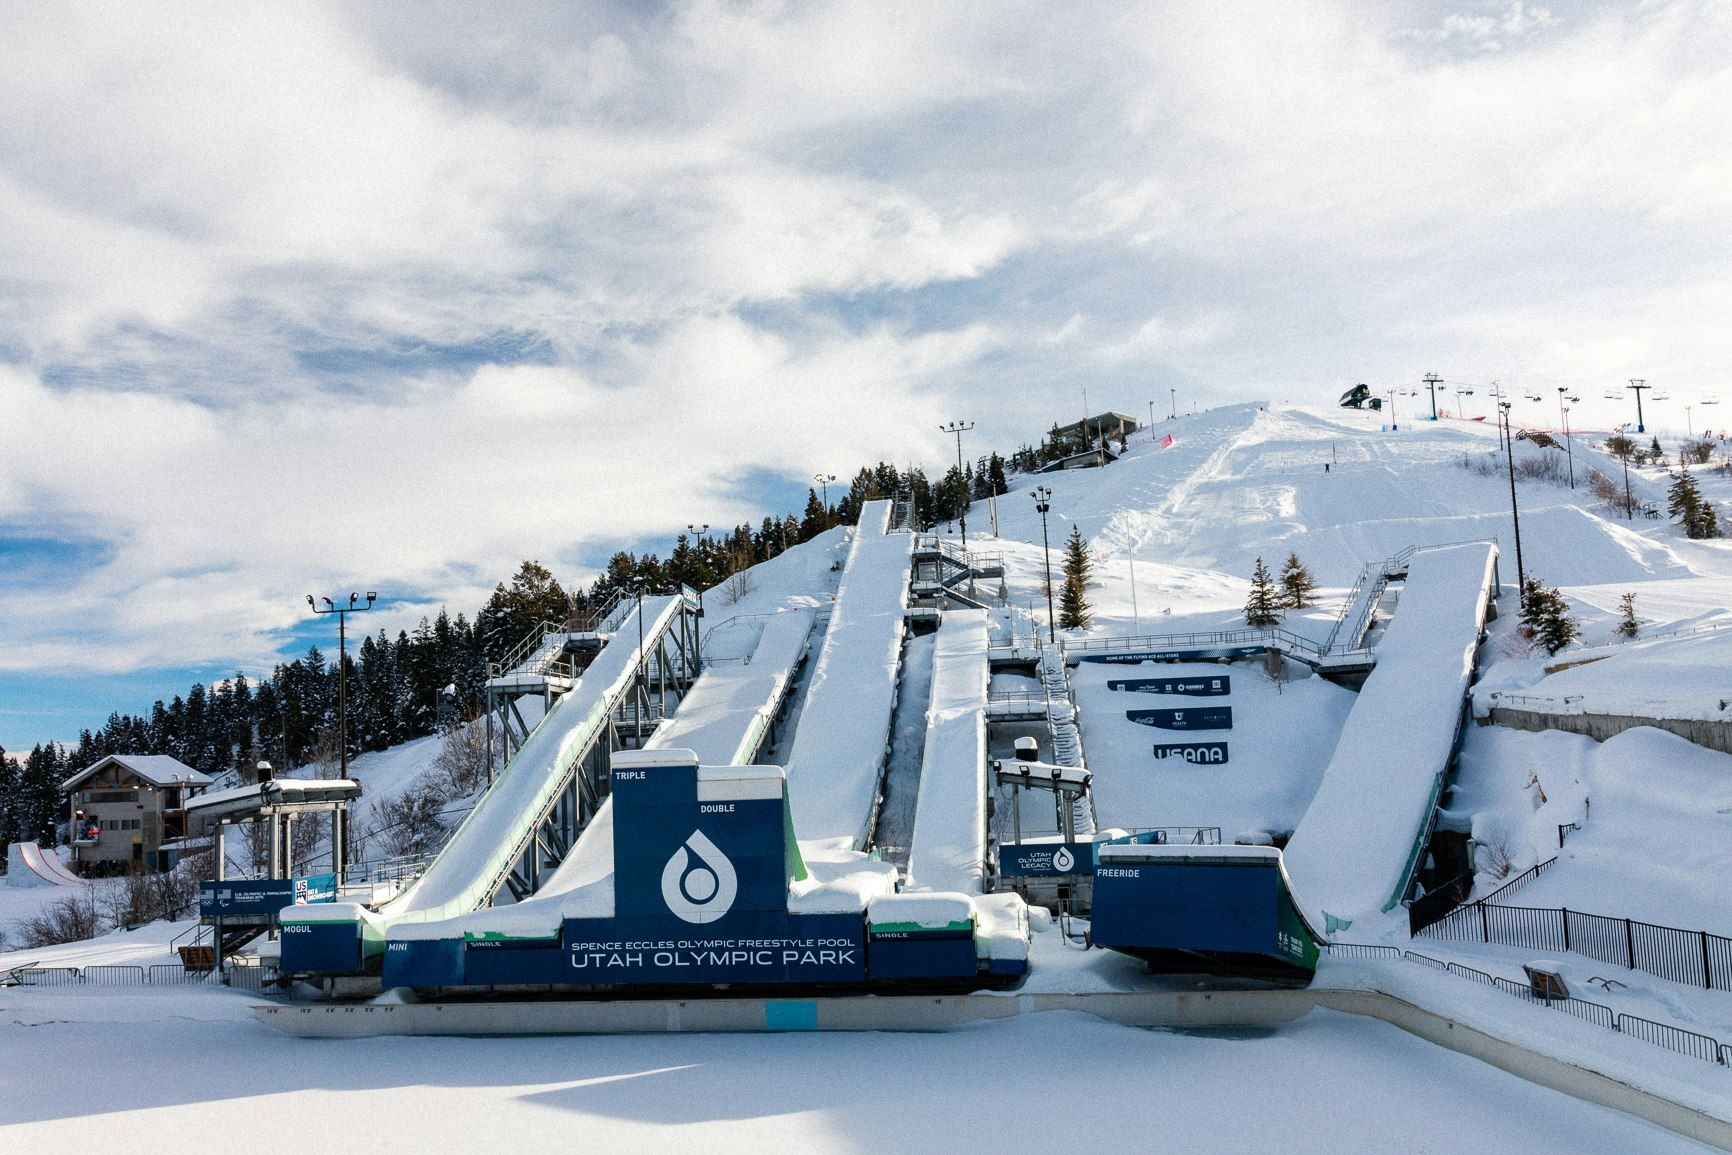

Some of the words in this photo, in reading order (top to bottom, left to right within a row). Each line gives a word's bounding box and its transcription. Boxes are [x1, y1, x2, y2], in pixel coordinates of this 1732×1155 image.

[615, 771, 646, 780] TRIPLE
[700, 804, 735, 813] DOUBLE
[1097, 868, 1140, 878] FREERIDE
[295, 881, 307, 892] US
[283, 925, 312, 934] MOGUL
[388, 943, 408, 951] MINI
[571, 942, 623, 951] SPENCE
[625, 940, 675, 950] ECCLES
[677, 939, 735, 949] OLYMPIC
[738, 939, 815, 948] FREESTYLE
[817, 938, 856, 947] POOL
[571, 952, 643, 968] UTAH
[653, 950, 773, 967] OLYMPIC
[782, 950, 856, 965] PARK
